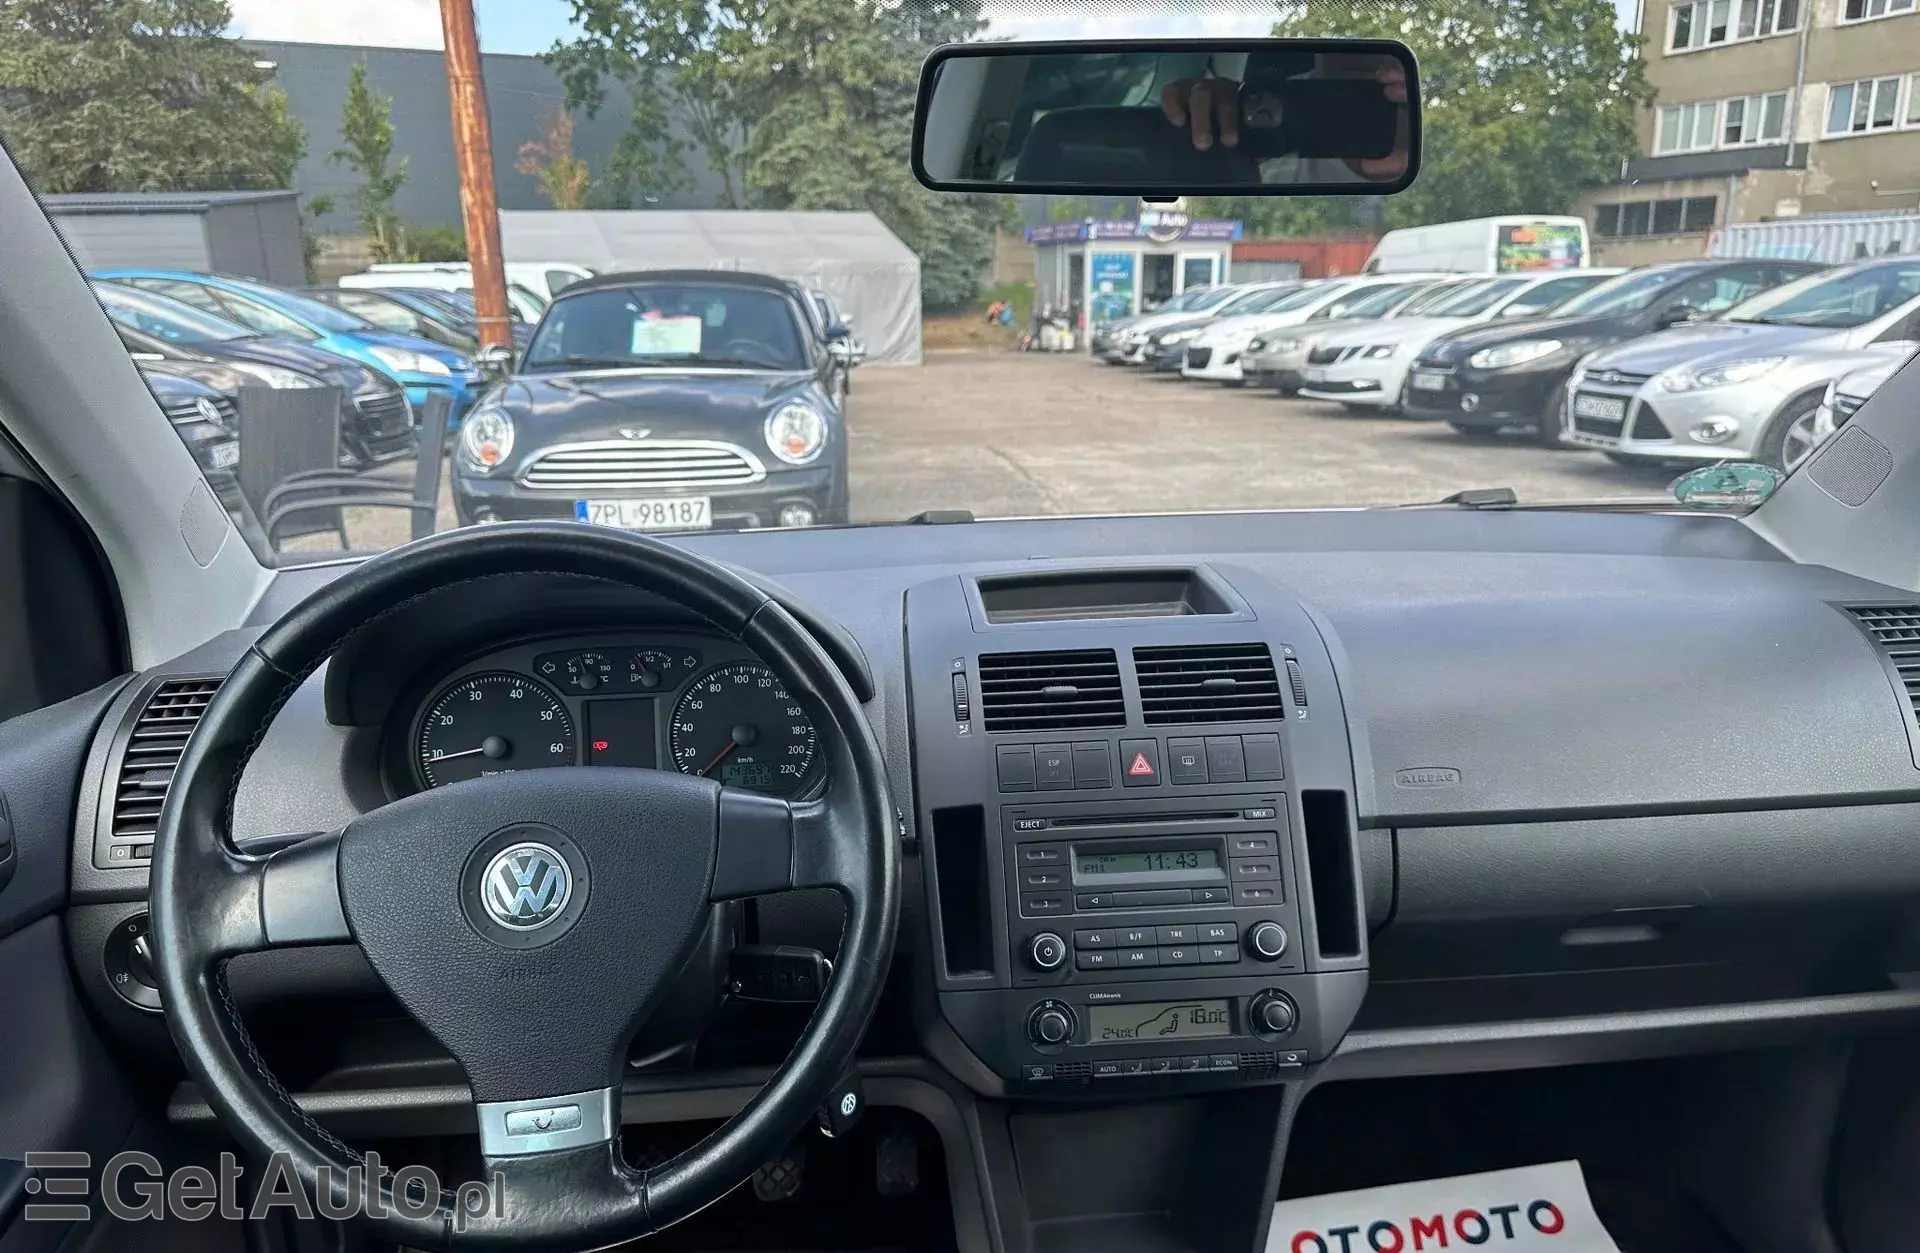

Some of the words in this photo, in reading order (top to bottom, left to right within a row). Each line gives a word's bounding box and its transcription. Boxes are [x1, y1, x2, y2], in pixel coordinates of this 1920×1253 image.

[639, 501, 705, 524] 98187
[733, 675, 749, 684] 100
[757, 678, 772, 687] 120
[709, 684, 722, 693] 80
[469, 691, 482, 701] 30
[509, 689, 523, 699] 40
[691, 700, 703, 710] 60
[540, 710, 553, 721] 50
[786, 707, 801, 716] 160
[440, 715, 454, 725] 20
[681, 723, 694, 732] 40
[791, 726, 807, 735] 180
[550, 743, 564, 753] 60
[684, 748, 696, 757] 20
[787, 745, 805, 754] 200
[431, 749, 444, 759] 10
[780, 764, 796, 774] 220
[1252, 810, 1267, 818] MIX
[1020, 820, 1041, 829] EJECT
[1144, 852, 1199, 870] 11:43
[1129, 933, 1143, 941] B/F
[1170, 930, 1183, 938] TRE
[1210, 929, 1225, 937] BAS
[1090, 935, 1101, 943] AS
[1091, 955, 1103, 963] FM
[1131, 953, 1144, 961] AM
[1172, 951, 1183, 959] CD
[1215, 1059, 1233, 1067] ECON
[1100, 1065, 1117, 1073] AUTO
[1290, 1199, 1565, 1253] OTOMOTO
